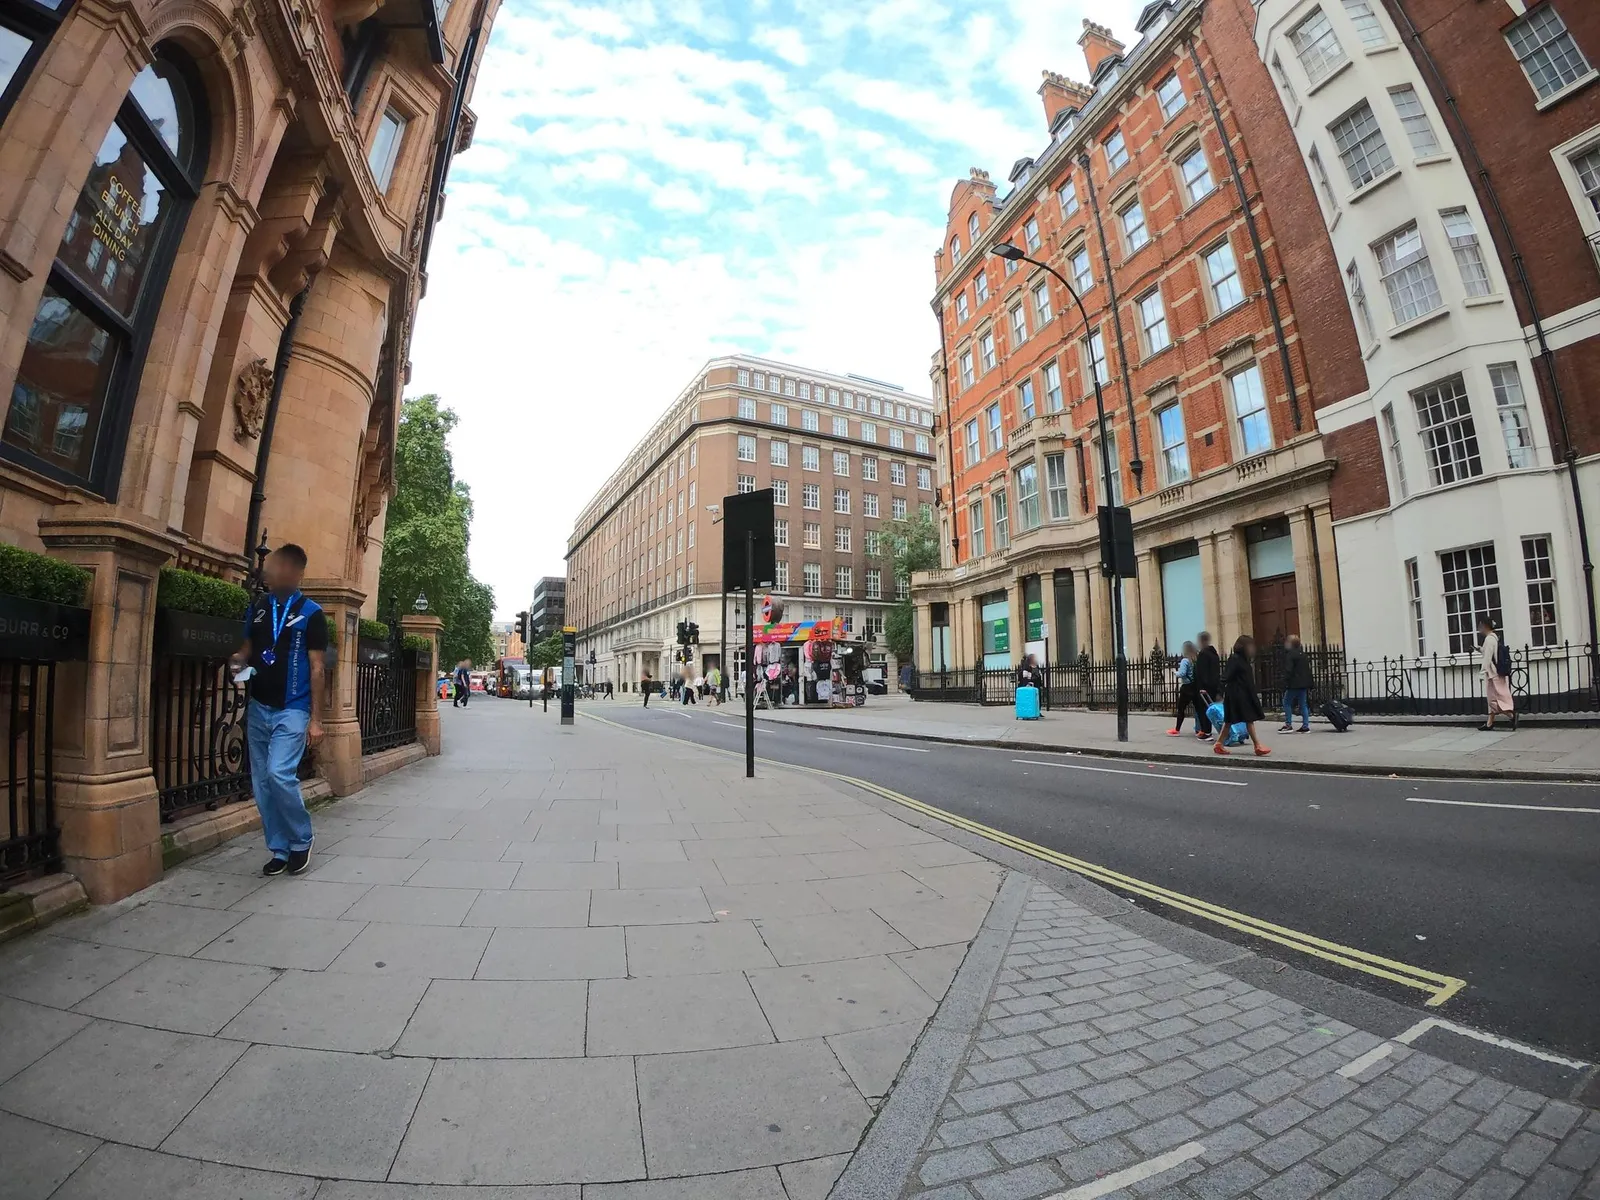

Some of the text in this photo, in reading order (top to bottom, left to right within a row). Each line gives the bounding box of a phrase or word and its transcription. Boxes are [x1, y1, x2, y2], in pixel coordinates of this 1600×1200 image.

[102, 190, 140, 236] BRUNCH
[110, 175, 142, 218] COFFEE
[92, 223, 126, 262] DINING
[95, 209, 133, 250] ALL DAY
[0, 617, 39, 636] BURR
[41, 626, 49, 638] &
[190, 629, 217, 642] BURR
[253, 609, 267, 623] 2
